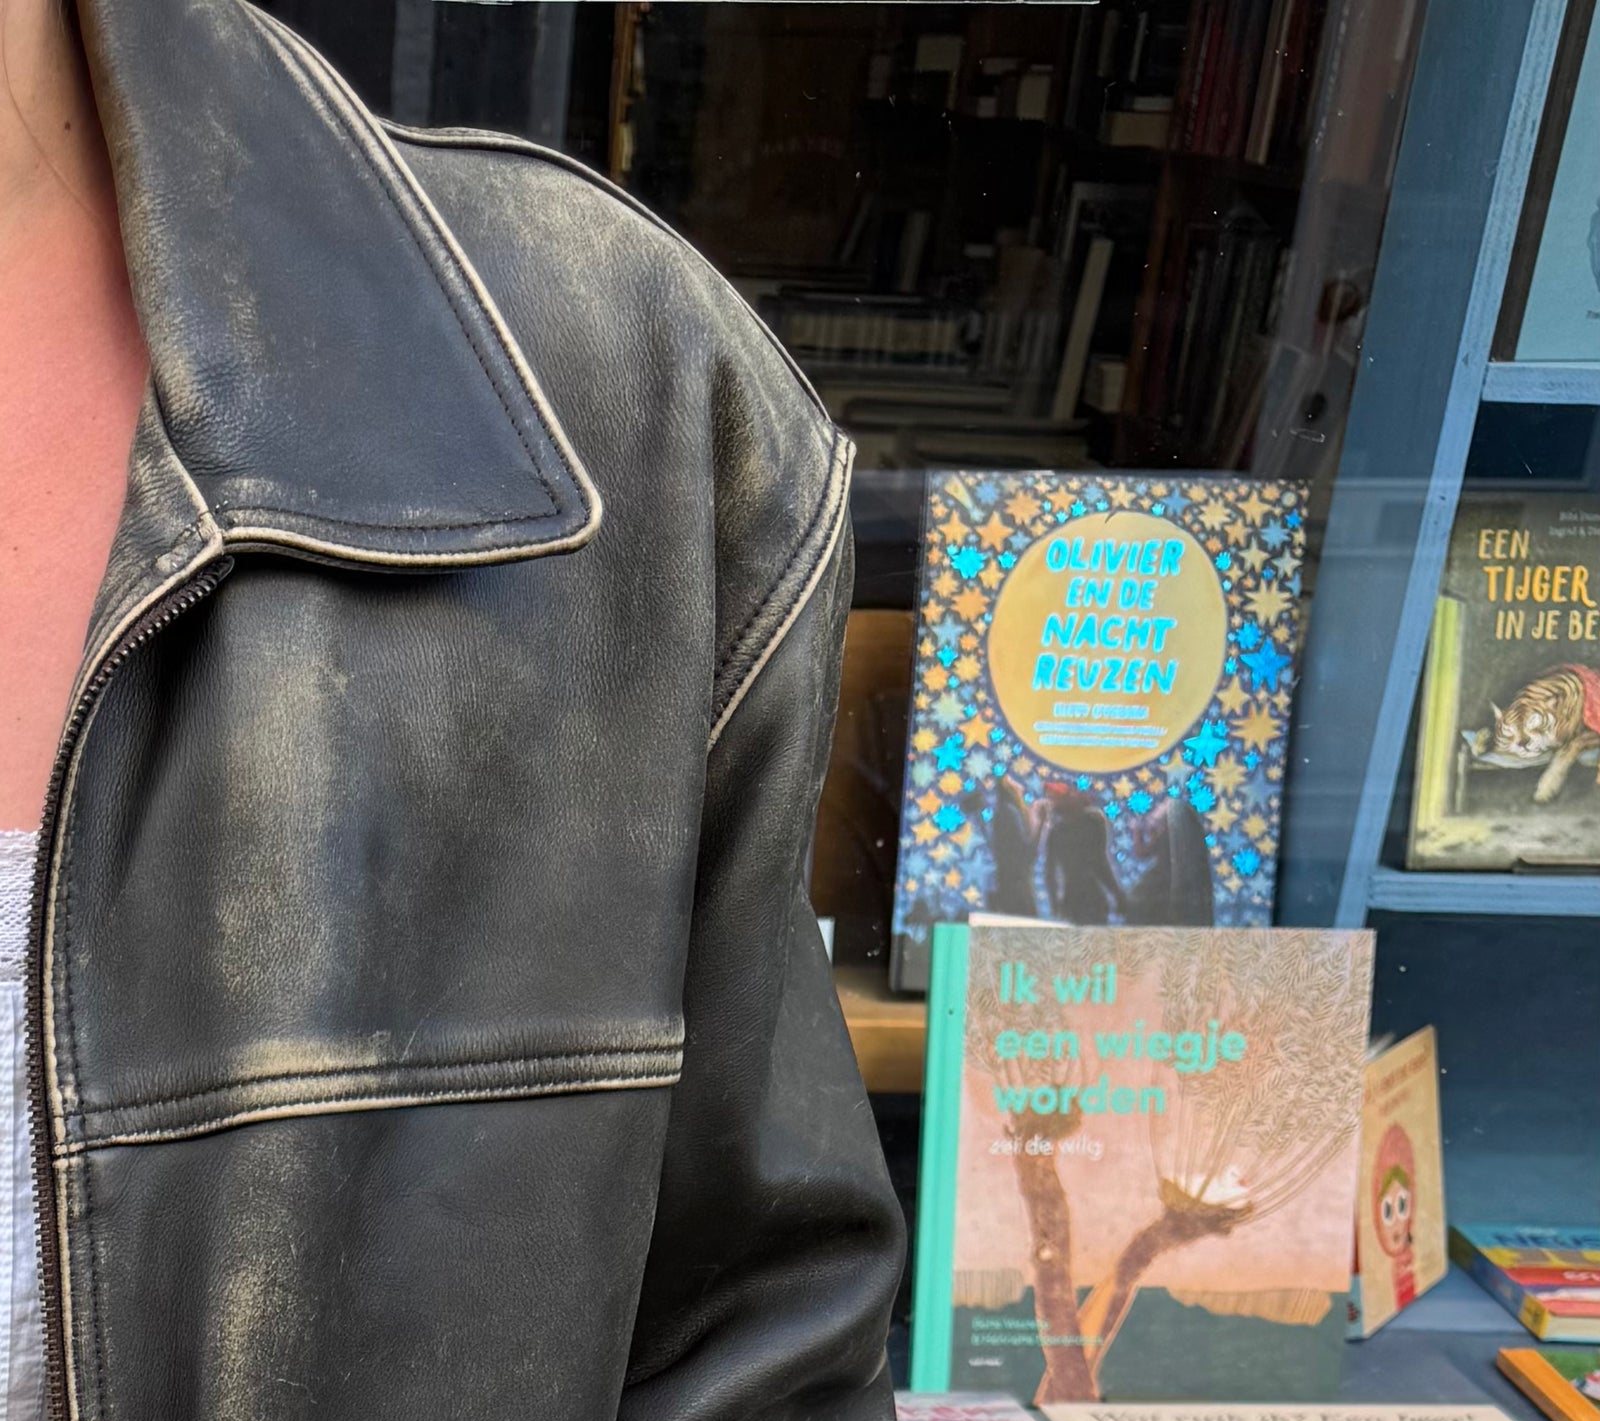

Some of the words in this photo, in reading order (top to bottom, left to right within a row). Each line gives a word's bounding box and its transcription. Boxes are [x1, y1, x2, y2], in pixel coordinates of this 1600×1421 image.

[1045, 536, 1185, 577] OLIVIER
[1477, 528, 1530, 560] EEN
[1065, 576, 1114, 608] EN
[1118, 577, 1158, 611] DE
[1482, 565, 1598, 608] TIJGER
[1040, 612, 1178, 653] NACHT
[1495, 609, 1525, 640] IN
[1531, 609, 1562, 641] JE
[1568, 609, 1600, 641] BE
[1031, 652, 1179, 695] REUZEN
[999, 961, 1040, 1005] Ik
[1052, 961, 1118, 1006] wil
[994, 1029, 1079, 1060] een
[1094, 1019, 1247, 1074] wiegje
[992, 1073, 1167, 1115] worden
[1024, 1134, 1053, 1157] de
[1056, 1135, 1105, 1161] wilg
